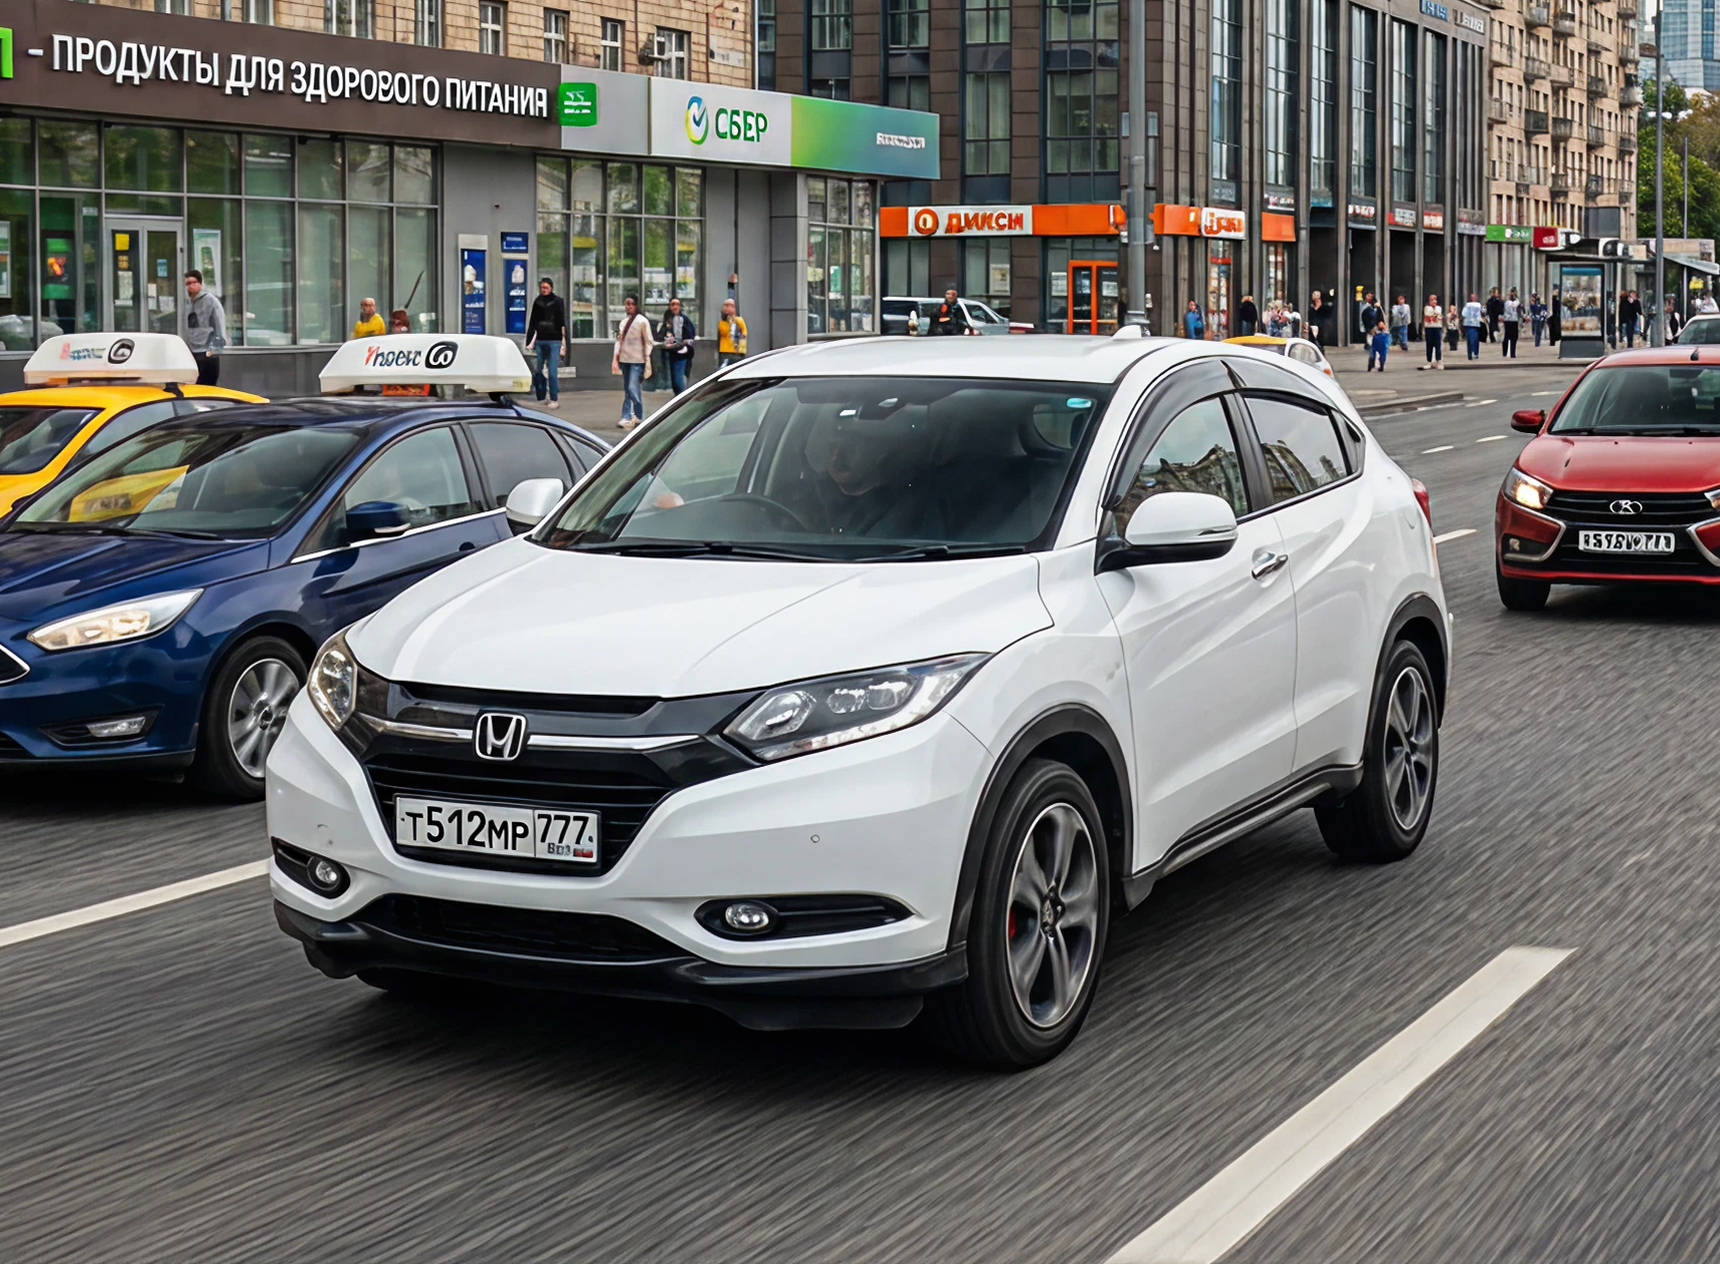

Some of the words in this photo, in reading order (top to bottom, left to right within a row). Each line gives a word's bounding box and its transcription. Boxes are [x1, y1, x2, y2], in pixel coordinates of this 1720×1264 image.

[52, 33, 220, 86] ПРОДУКТЫ
[225, 53, 284, 96] ДЛЯ
[290, 60, 440, 107] ЗДОРОВОГО
[445, 77, 548, 118] ПИТАНИЯ
[714, 107, 768, 143] СБЕР
[537, 813, 590, 845] 777
